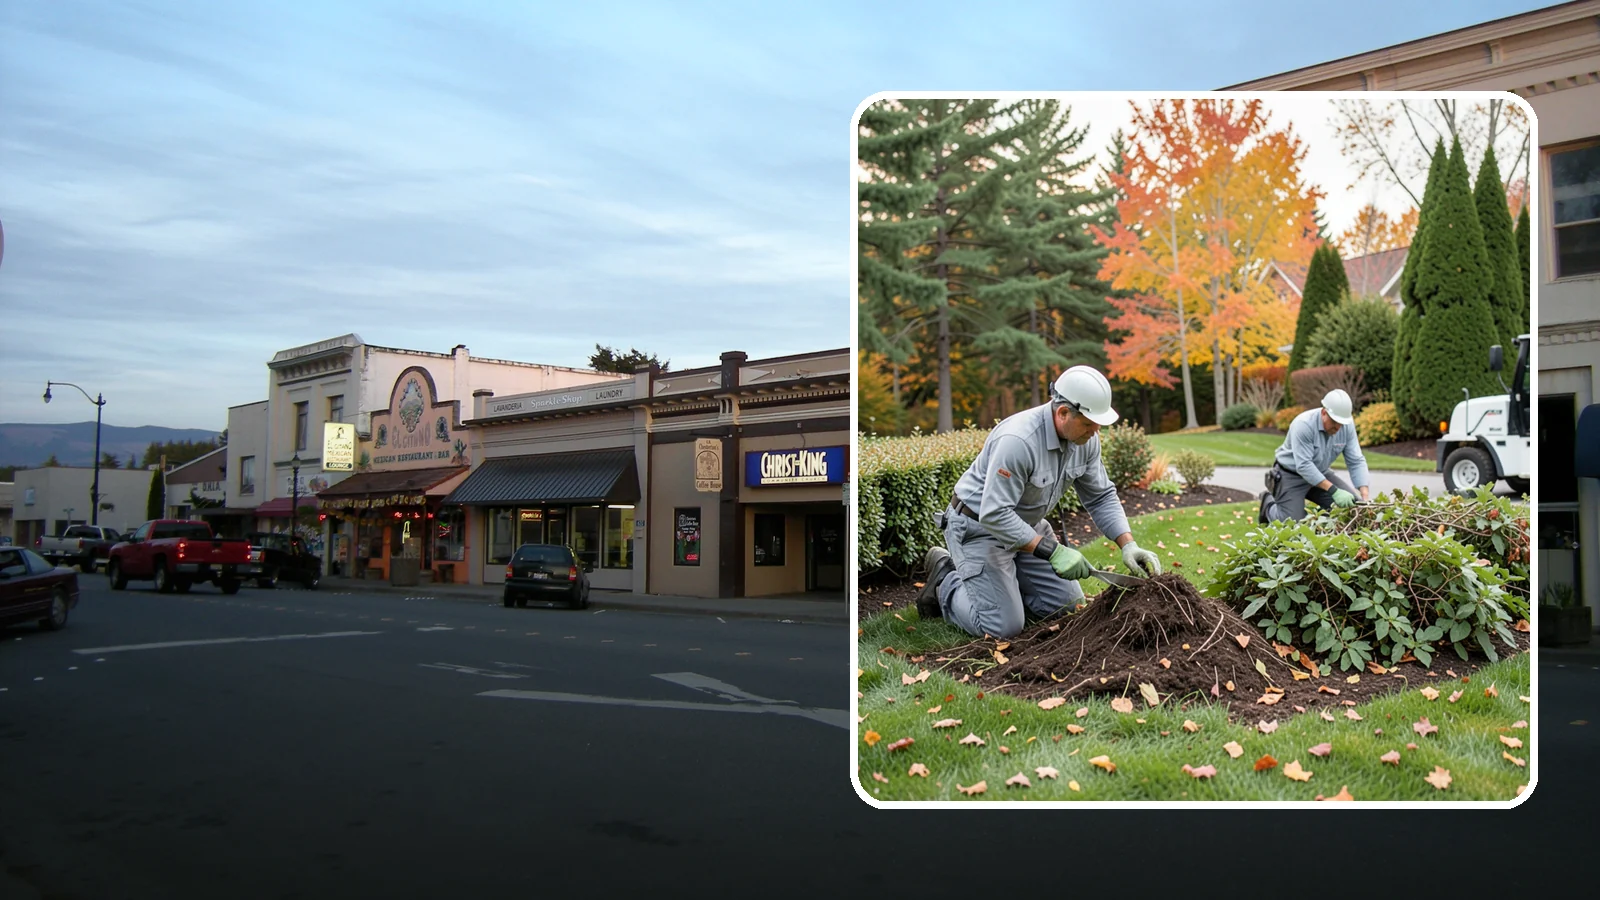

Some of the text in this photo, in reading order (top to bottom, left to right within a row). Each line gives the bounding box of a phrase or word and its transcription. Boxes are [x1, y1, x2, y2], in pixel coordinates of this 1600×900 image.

[493, 389, 623, 412] LAVANDERIA Sparkle Shop LAUNDRY
[373, 455, 396, 464] MEXICAN
[397, 451, 433, 462] RESTAURANT
[437, 450, 450, 459] BAR
[761, 450, 827, 478] CHRIST KING
